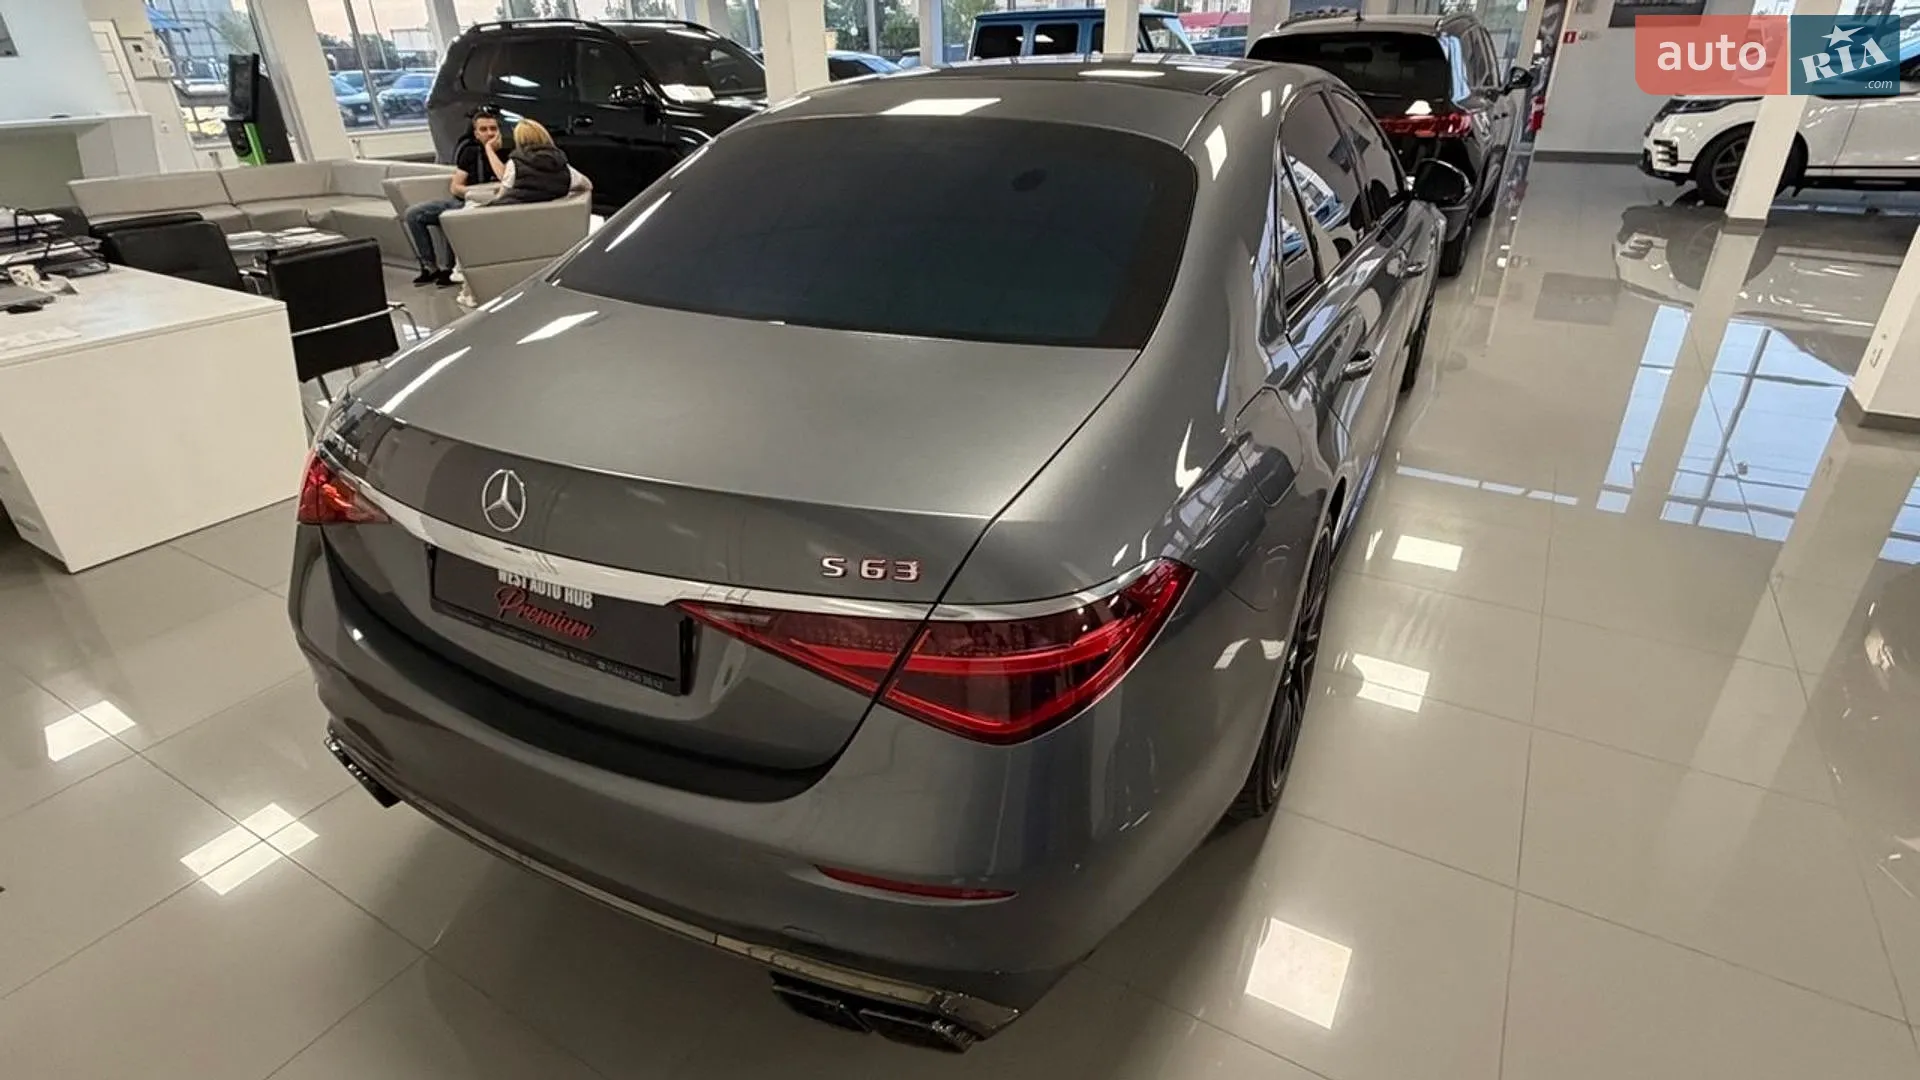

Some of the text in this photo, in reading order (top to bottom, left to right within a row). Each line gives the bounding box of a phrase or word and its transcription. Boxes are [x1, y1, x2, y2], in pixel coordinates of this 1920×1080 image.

[821, 557, 918, 581] S 63
[564, 587, 593, 610] HUB
[495, 586, 596, 640] Premium
